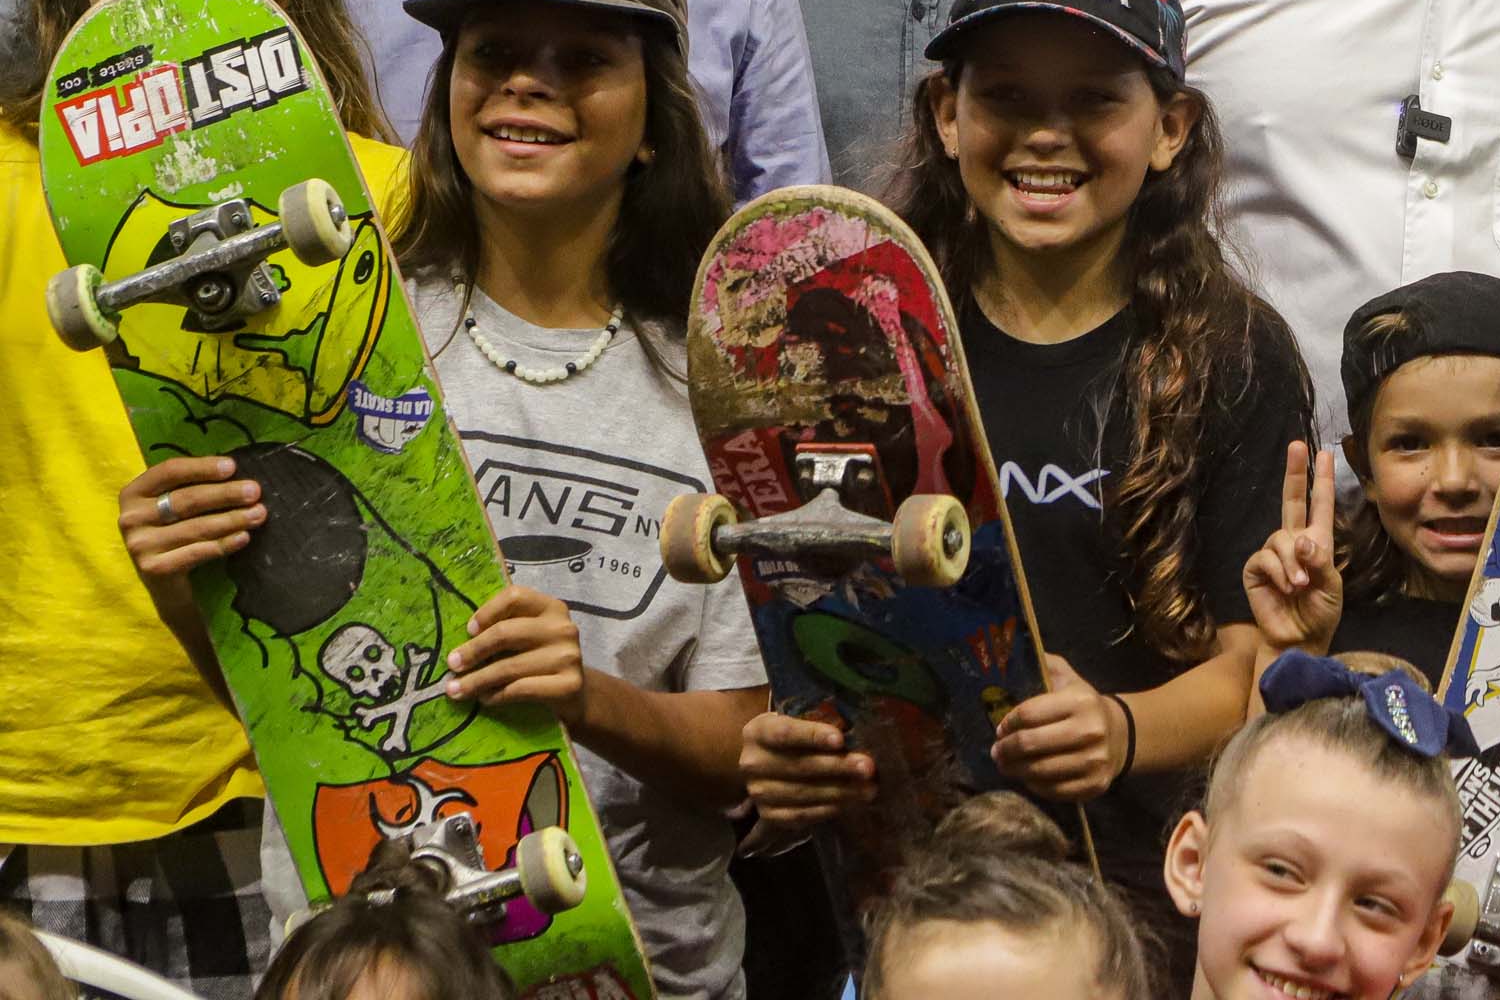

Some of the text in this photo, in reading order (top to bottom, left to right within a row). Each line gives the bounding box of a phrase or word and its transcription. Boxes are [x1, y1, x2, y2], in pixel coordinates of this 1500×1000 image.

[100, 52, 145, 79] skate
[354, 388, 394, 414] SKATE
[395, 400, 412, 415] DE
[598, 556, 642, 578] 1966
[1457, 763, 1492, 809] ANS
